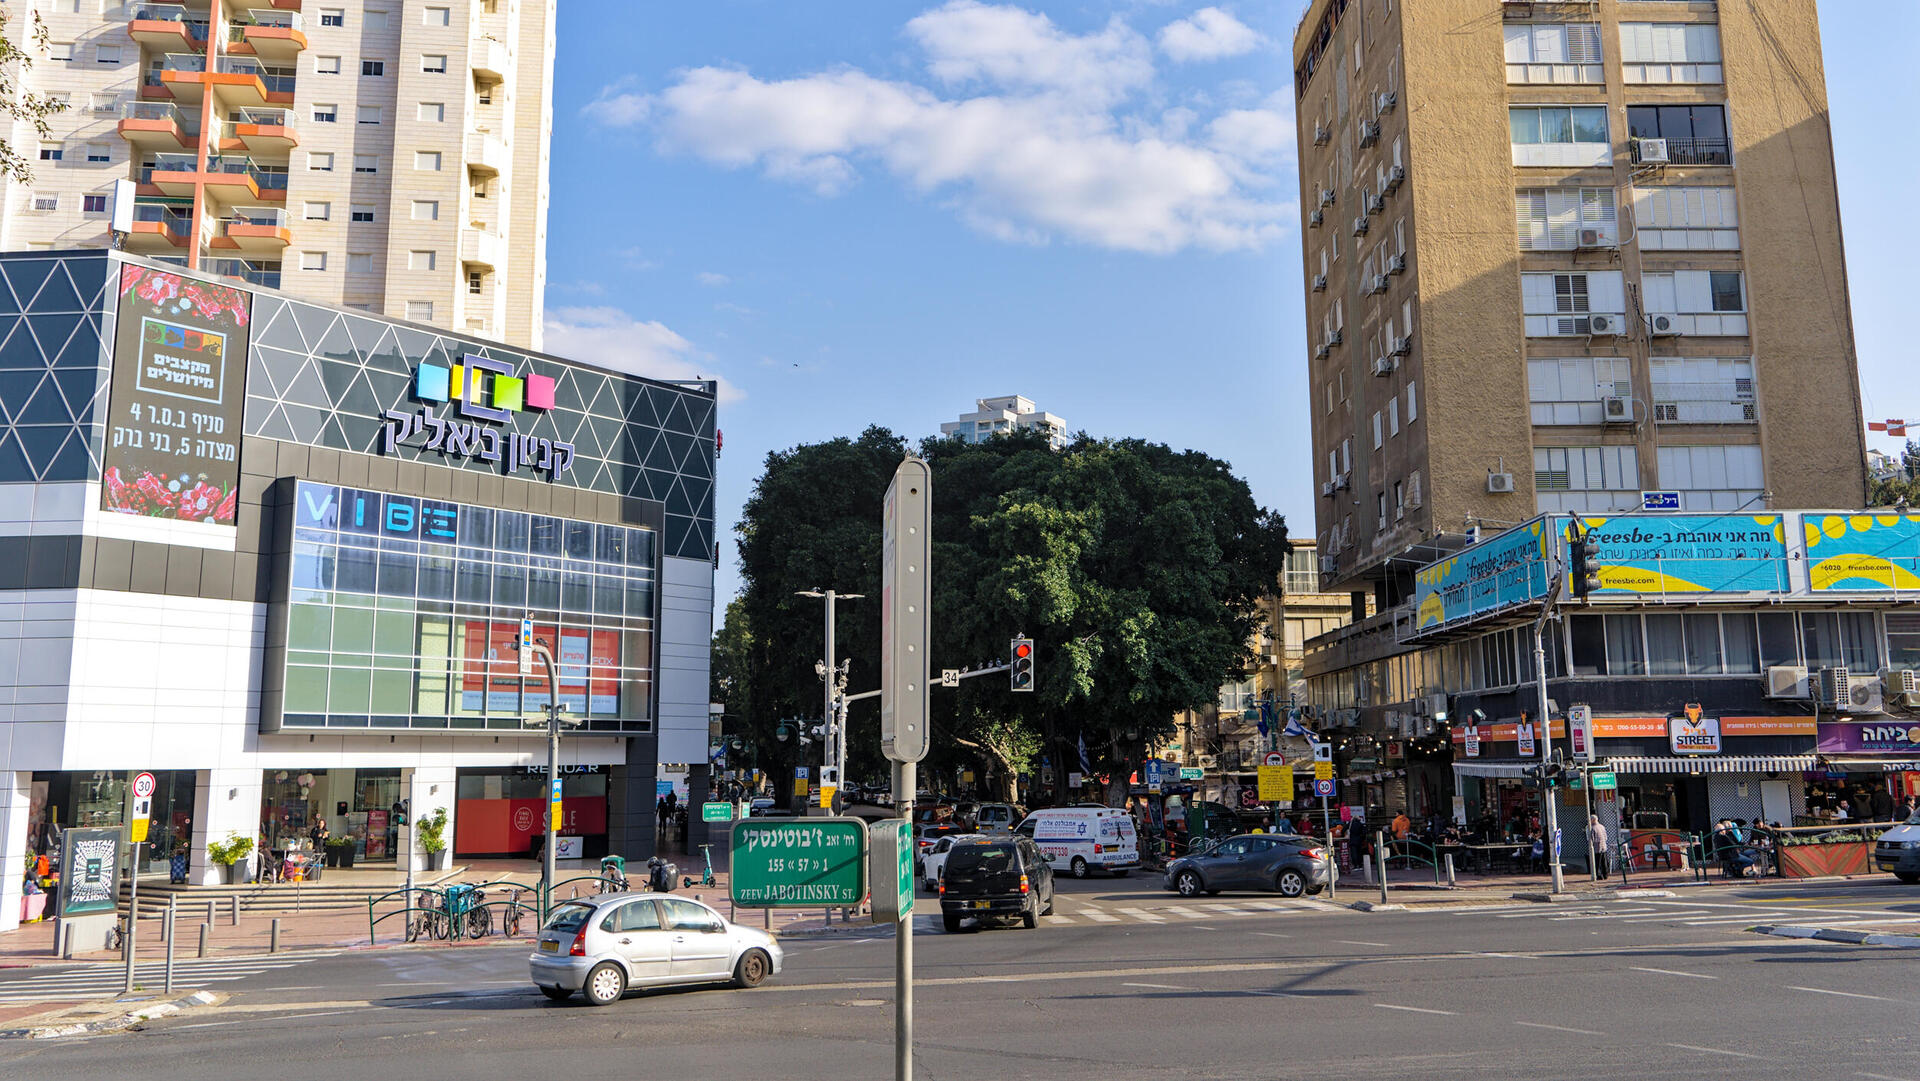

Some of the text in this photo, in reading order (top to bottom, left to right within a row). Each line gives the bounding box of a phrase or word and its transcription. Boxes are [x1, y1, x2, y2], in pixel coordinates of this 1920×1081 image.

[153, 352, 211, 375] הקצבים
[146, 366, 214, 390] מירושלים
[130, 402, 224, 434] סניף ב.ס.ר 4
[113, 426, 235, 462] מצדה 5, בני ברק
[384, 406, 575, 481] קניון ביאליק
[303, 490, 457, 538] VIBE
[1676, 529, 1722, 543] אוהבת
[1725, 529, 1746, 542] אני
[1750, 530, 1771, 542] מה
[1605, 576, 1655, 584] freesbe.com
[592, 656, 613, 666] FOX
[944, 672, 957, 683] 34
[1682, 727, 1707, 736] גריל
[1676, 735, 1716, 745] STREET
[138, 780, 150, 792] 30
[1320, 782, 1330, 791] 30
[542, 810, 576, 827] SLE
[742, 827, 855, 853] רח' זאב ז'בוטינסקי
[1103, 852, 1137, 861] AMBULANCE
[768, 858, 828, 872] 155 57 1
[740, 884, 855, 901] ZEEV JABOTINSKY ST.
